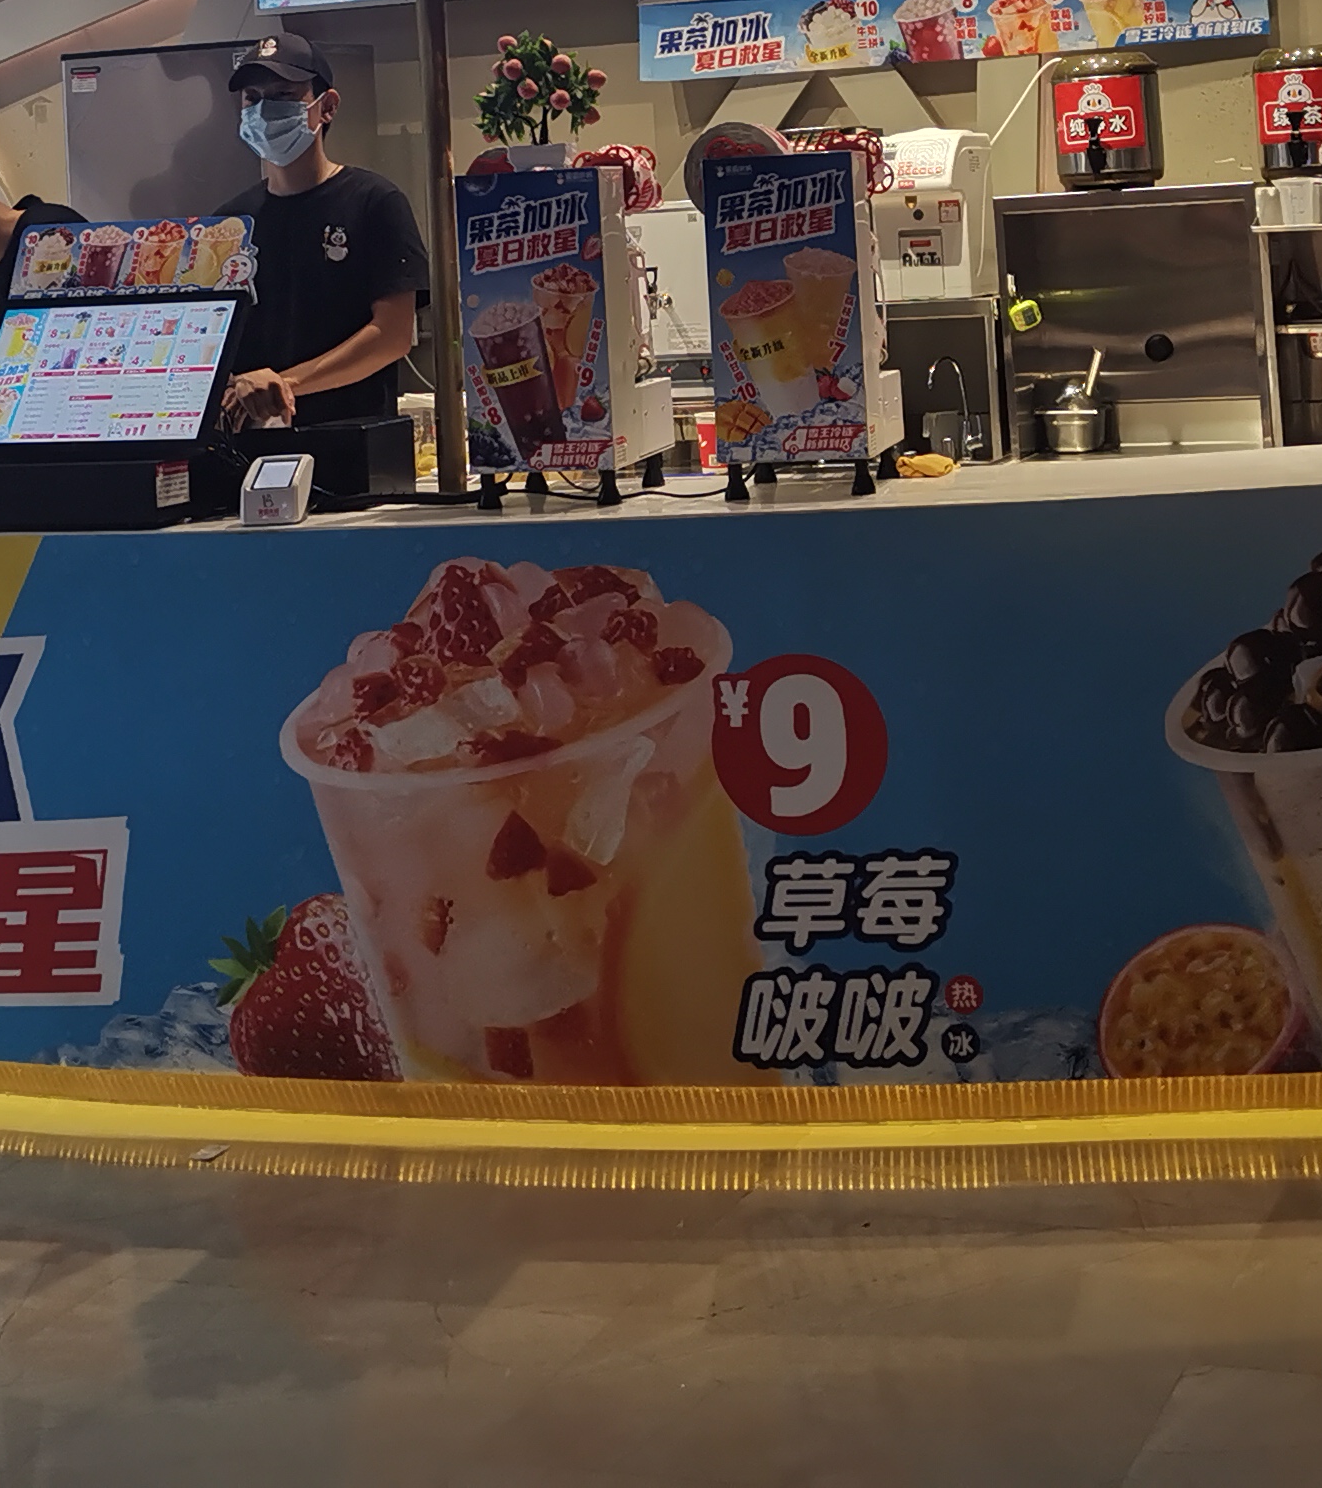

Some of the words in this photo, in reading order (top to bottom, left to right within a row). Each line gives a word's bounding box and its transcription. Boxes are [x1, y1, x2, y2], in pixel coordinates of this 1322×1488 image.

[658, 12, 770, 55] 果茶加冰
[1196, 17, 1263, 39] 新鲜到店
[694, 40, 782, 72] 夏日救星
[1069, 114, 1128, 137] 纯水
[469, 193, 586, 245] 果茶加冰
[719, 172, 844, 224] 果茶加冰
[475, 227, 577, 272] 夏日救星
[725, 206, 833, 252] 夏日救星
[719, 673, 848, 818] ¥9
[761, 854, 952, 949] 草莓
[740, 970, 933, 1062] 啵啵
[949, 981, 979, 1009] 热
[946, 1029, 975, 1058] 冰
